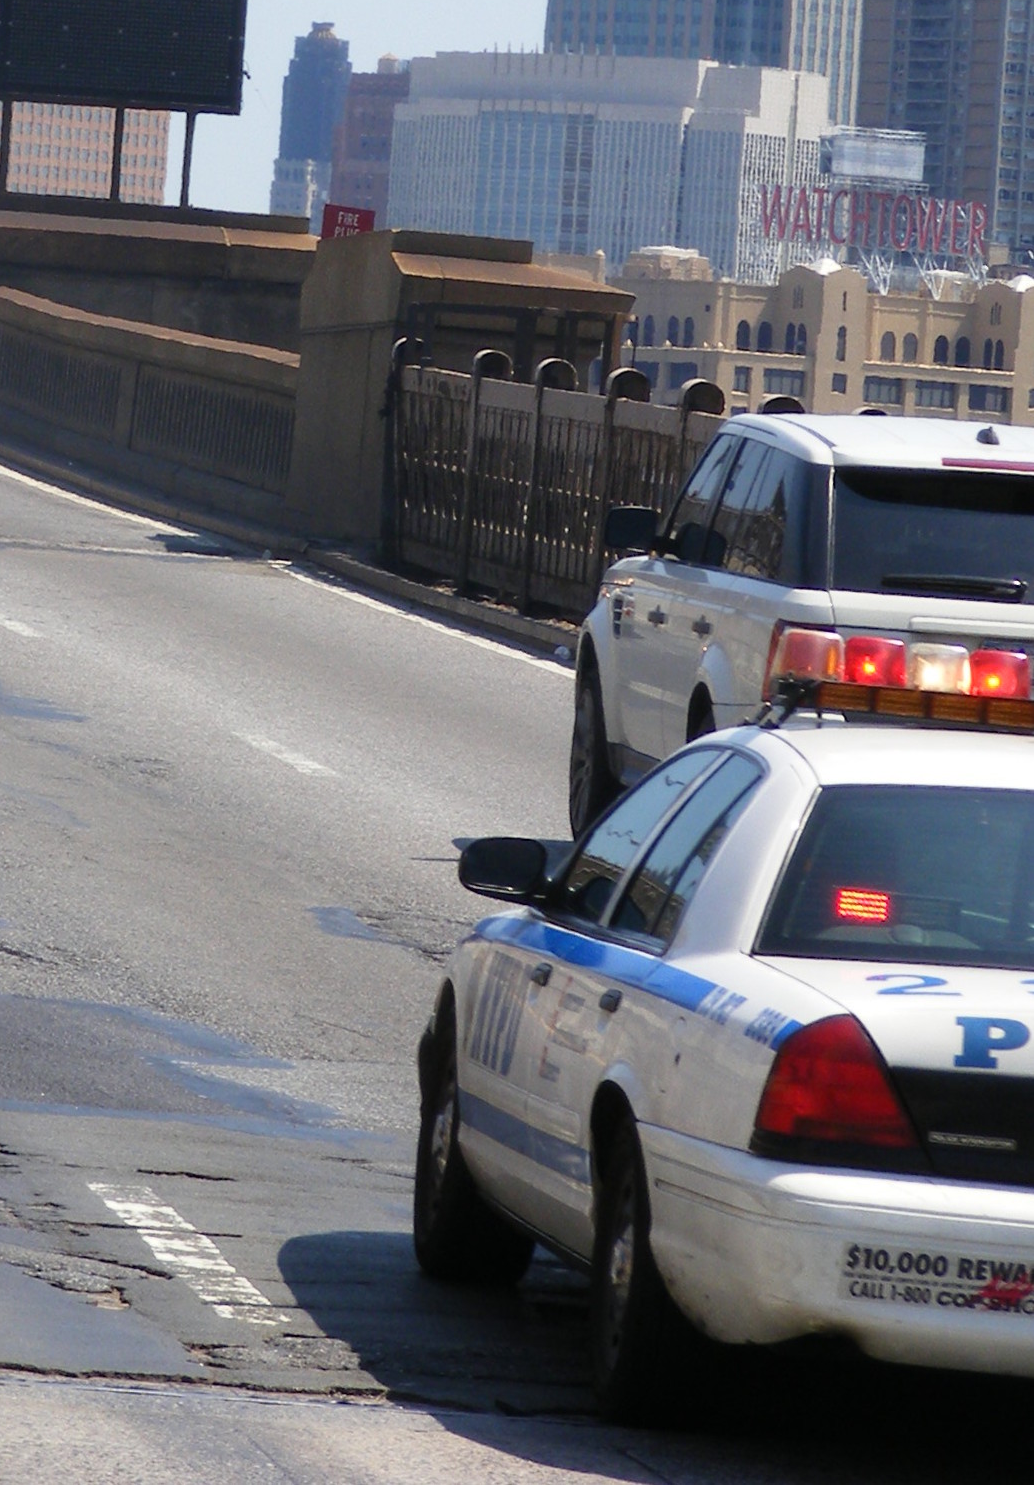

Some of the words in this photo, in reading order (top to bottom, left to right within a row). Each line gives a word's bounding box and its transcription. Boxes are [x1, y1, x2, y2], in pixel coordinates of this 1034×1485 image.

[337, 211, 359, 226] FIRE
[761, 184, 987, 256] WATCHTOWER
[846, 1244, 948, 1277] $10,000
[957, 1257, 1034, 1283] REWA
[849, 1280, 885, 1300] CALL
[891, 1284, 931, 1304] 1-800
